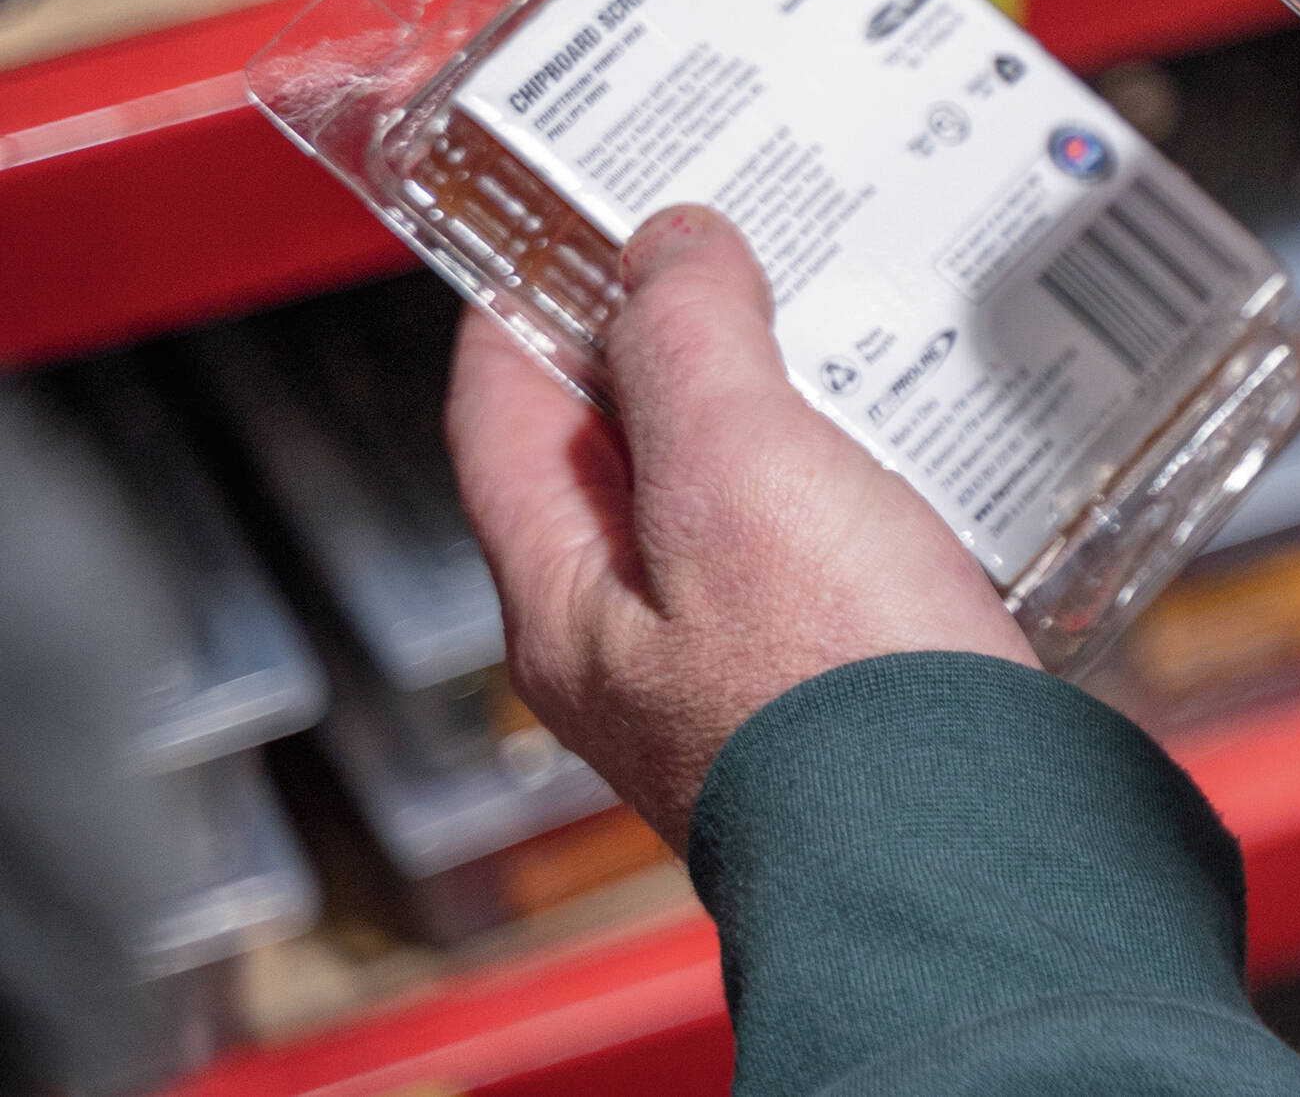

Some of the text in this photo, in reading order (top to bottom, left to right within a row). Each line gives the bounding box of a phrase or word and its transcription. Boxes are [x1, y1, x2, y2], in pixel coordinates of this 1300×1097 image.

[509, 25, 600, 112] CHIPBOARD
[547, 104, 585, 140] PHILLIPS
[891, 347, 942, 395] PROLINE
